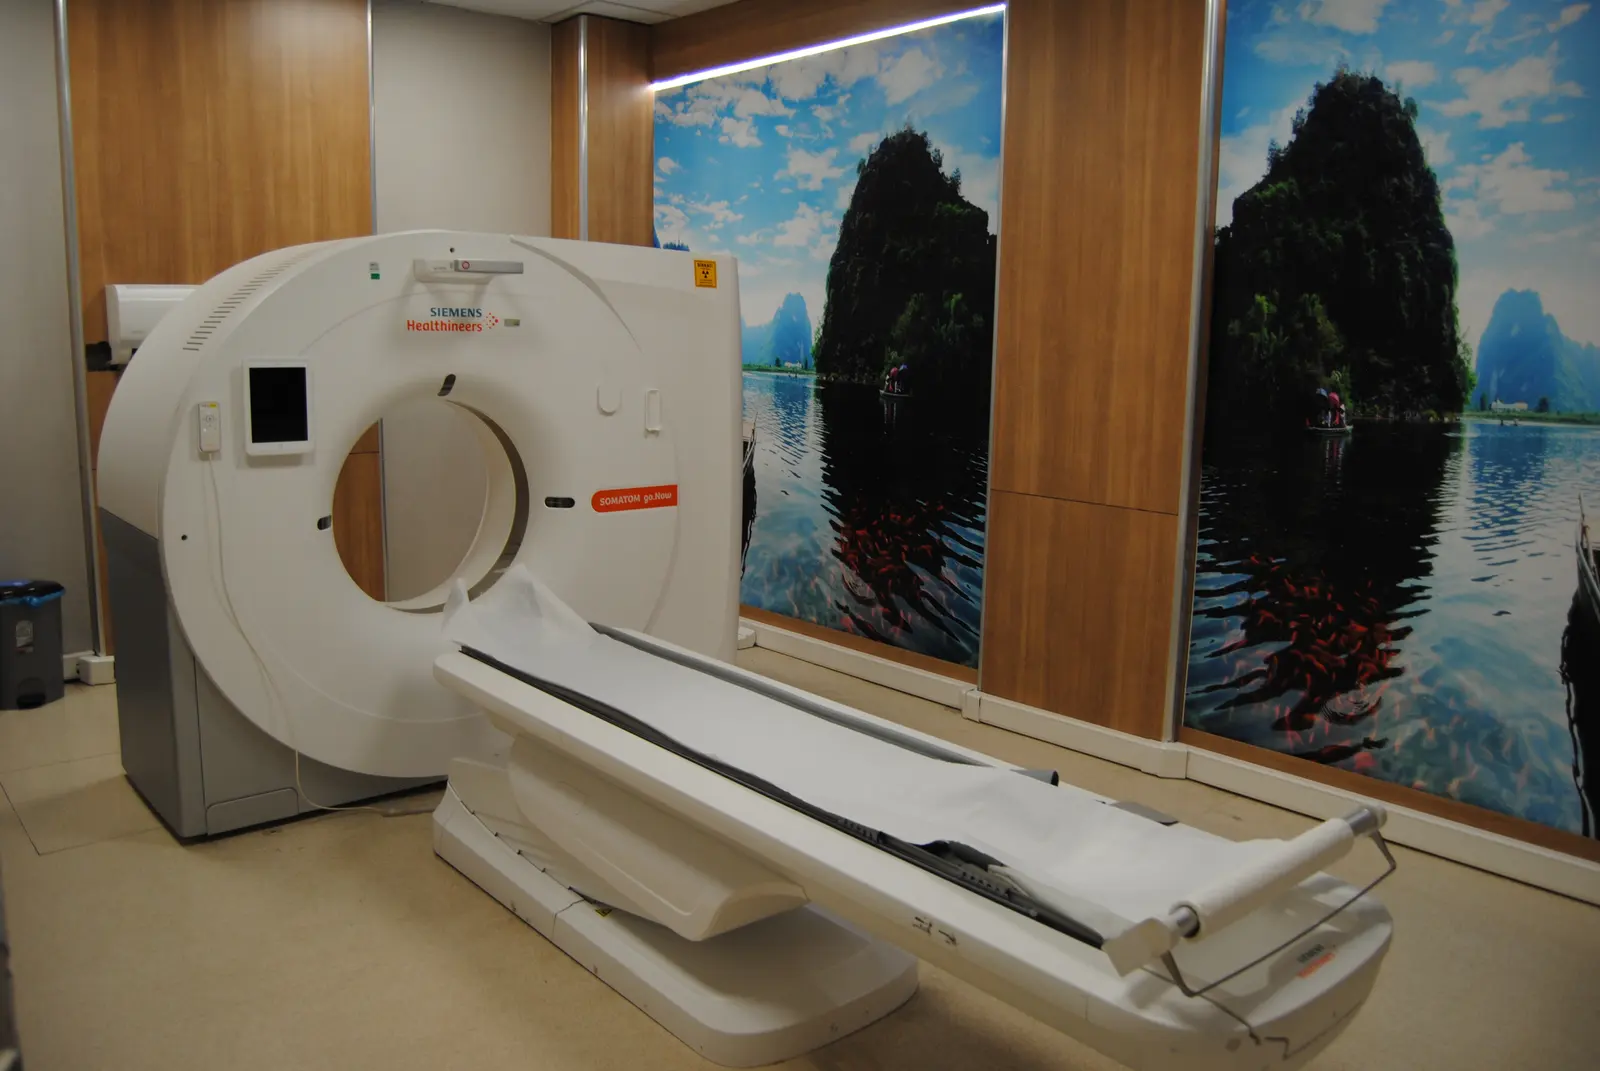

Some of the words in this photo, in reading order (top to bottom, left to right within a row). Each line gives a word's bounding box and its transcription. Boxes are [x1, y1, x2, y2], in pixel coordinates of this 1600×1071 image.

[430, 307, 482, 318] SIEMENS
[406, 319, 483, 332] Healthineers
[599, 494, 641, 506] SOMATOM
[643, 492, 672, 504] go.Now
